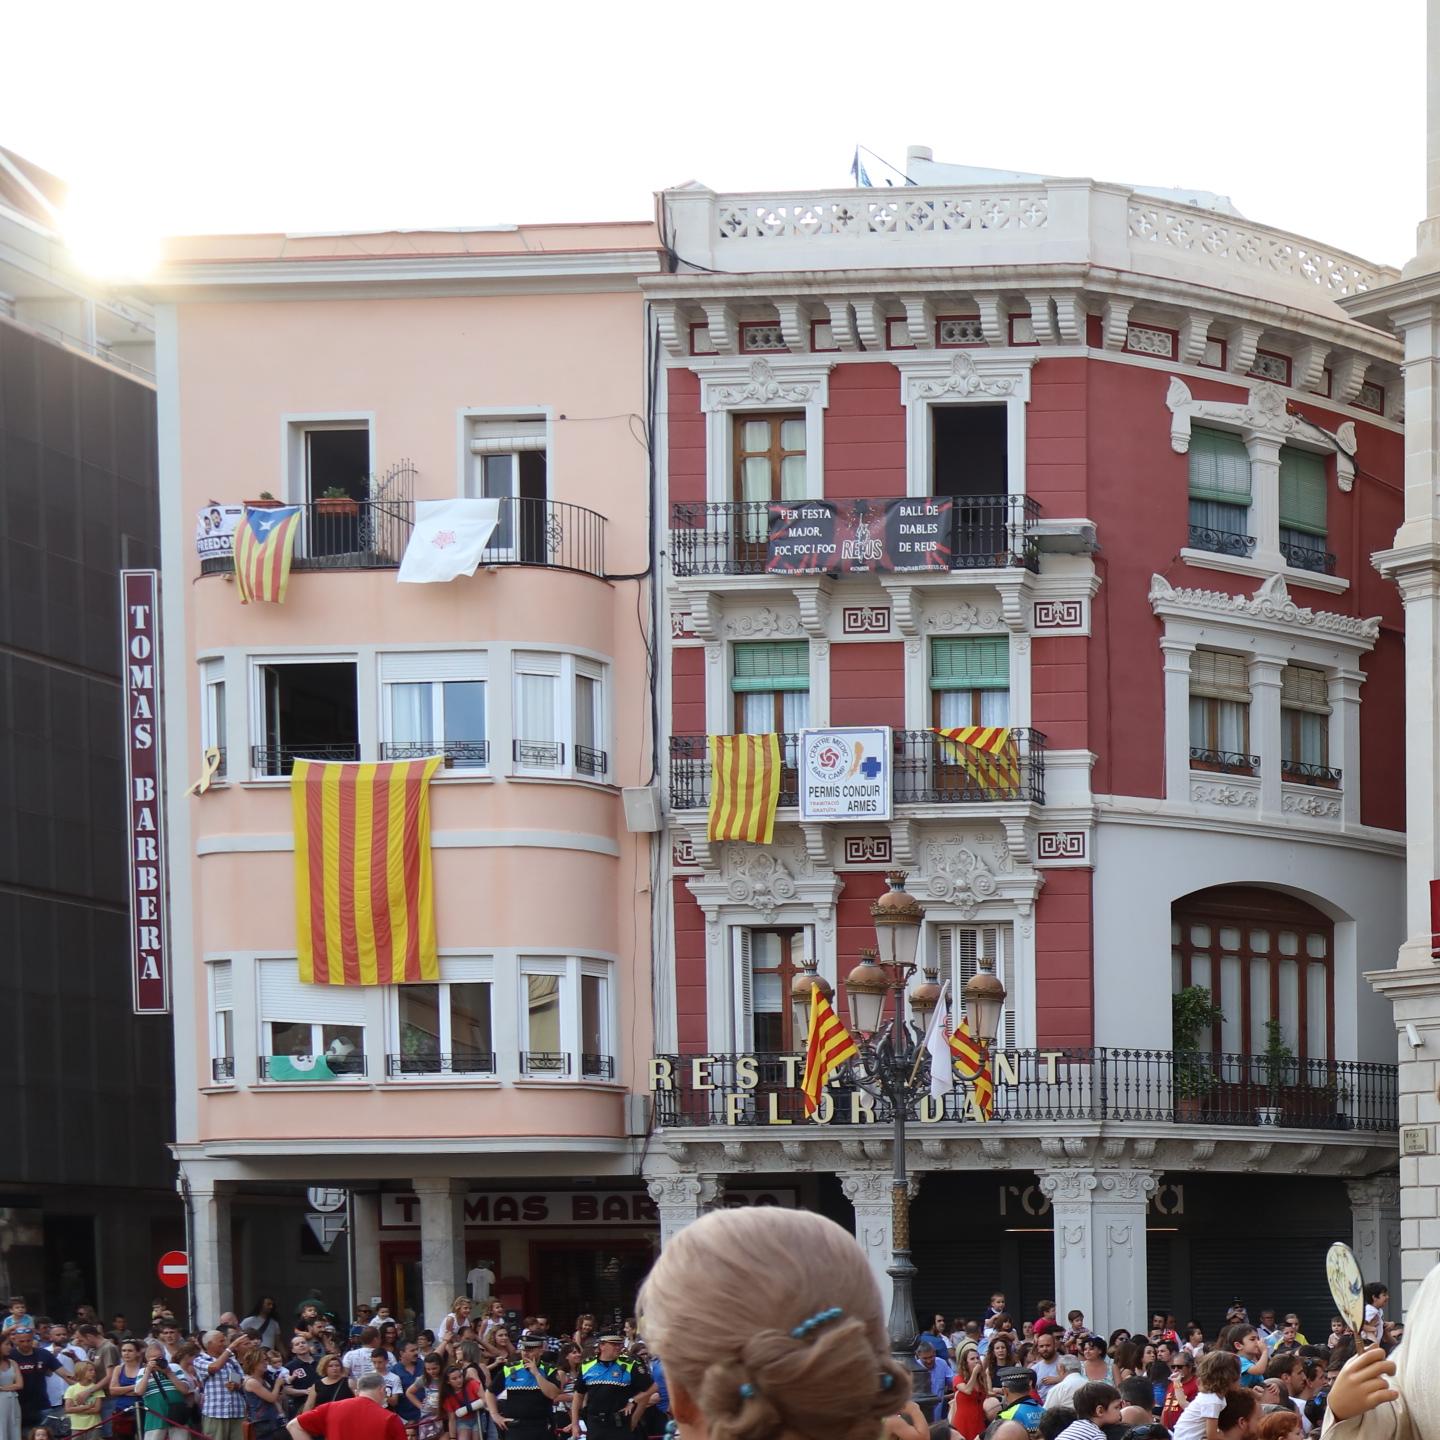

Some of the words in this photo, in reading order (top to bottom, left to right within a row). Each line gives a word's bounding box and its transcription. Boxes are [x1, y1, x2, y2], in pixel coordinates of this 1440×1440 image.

[781, 508, 799, 520] PER
[802, 509, 831, 519] FESTA
[900, 506, 922, 516] BALL
[926, 505, 938, 516] DE
[788, 526, 823, 537] MAJOR,
[900, 523, 938, 534] DIABLES
[794, 544, 811, 554] FOC
[841, 540, 883, 560] REUS
[899, 541, 912, 552] DE
[915, 540, 937, 552] REUS
[130, 604, 154, 750] TOMÀS
[842, 785, 881, 797] CONDUIR
[847, 800, 877, 812] ARMES
[134, 777, 162, 980] BARBERÀ
[726, 1091, 988, 1125] FLORDA
